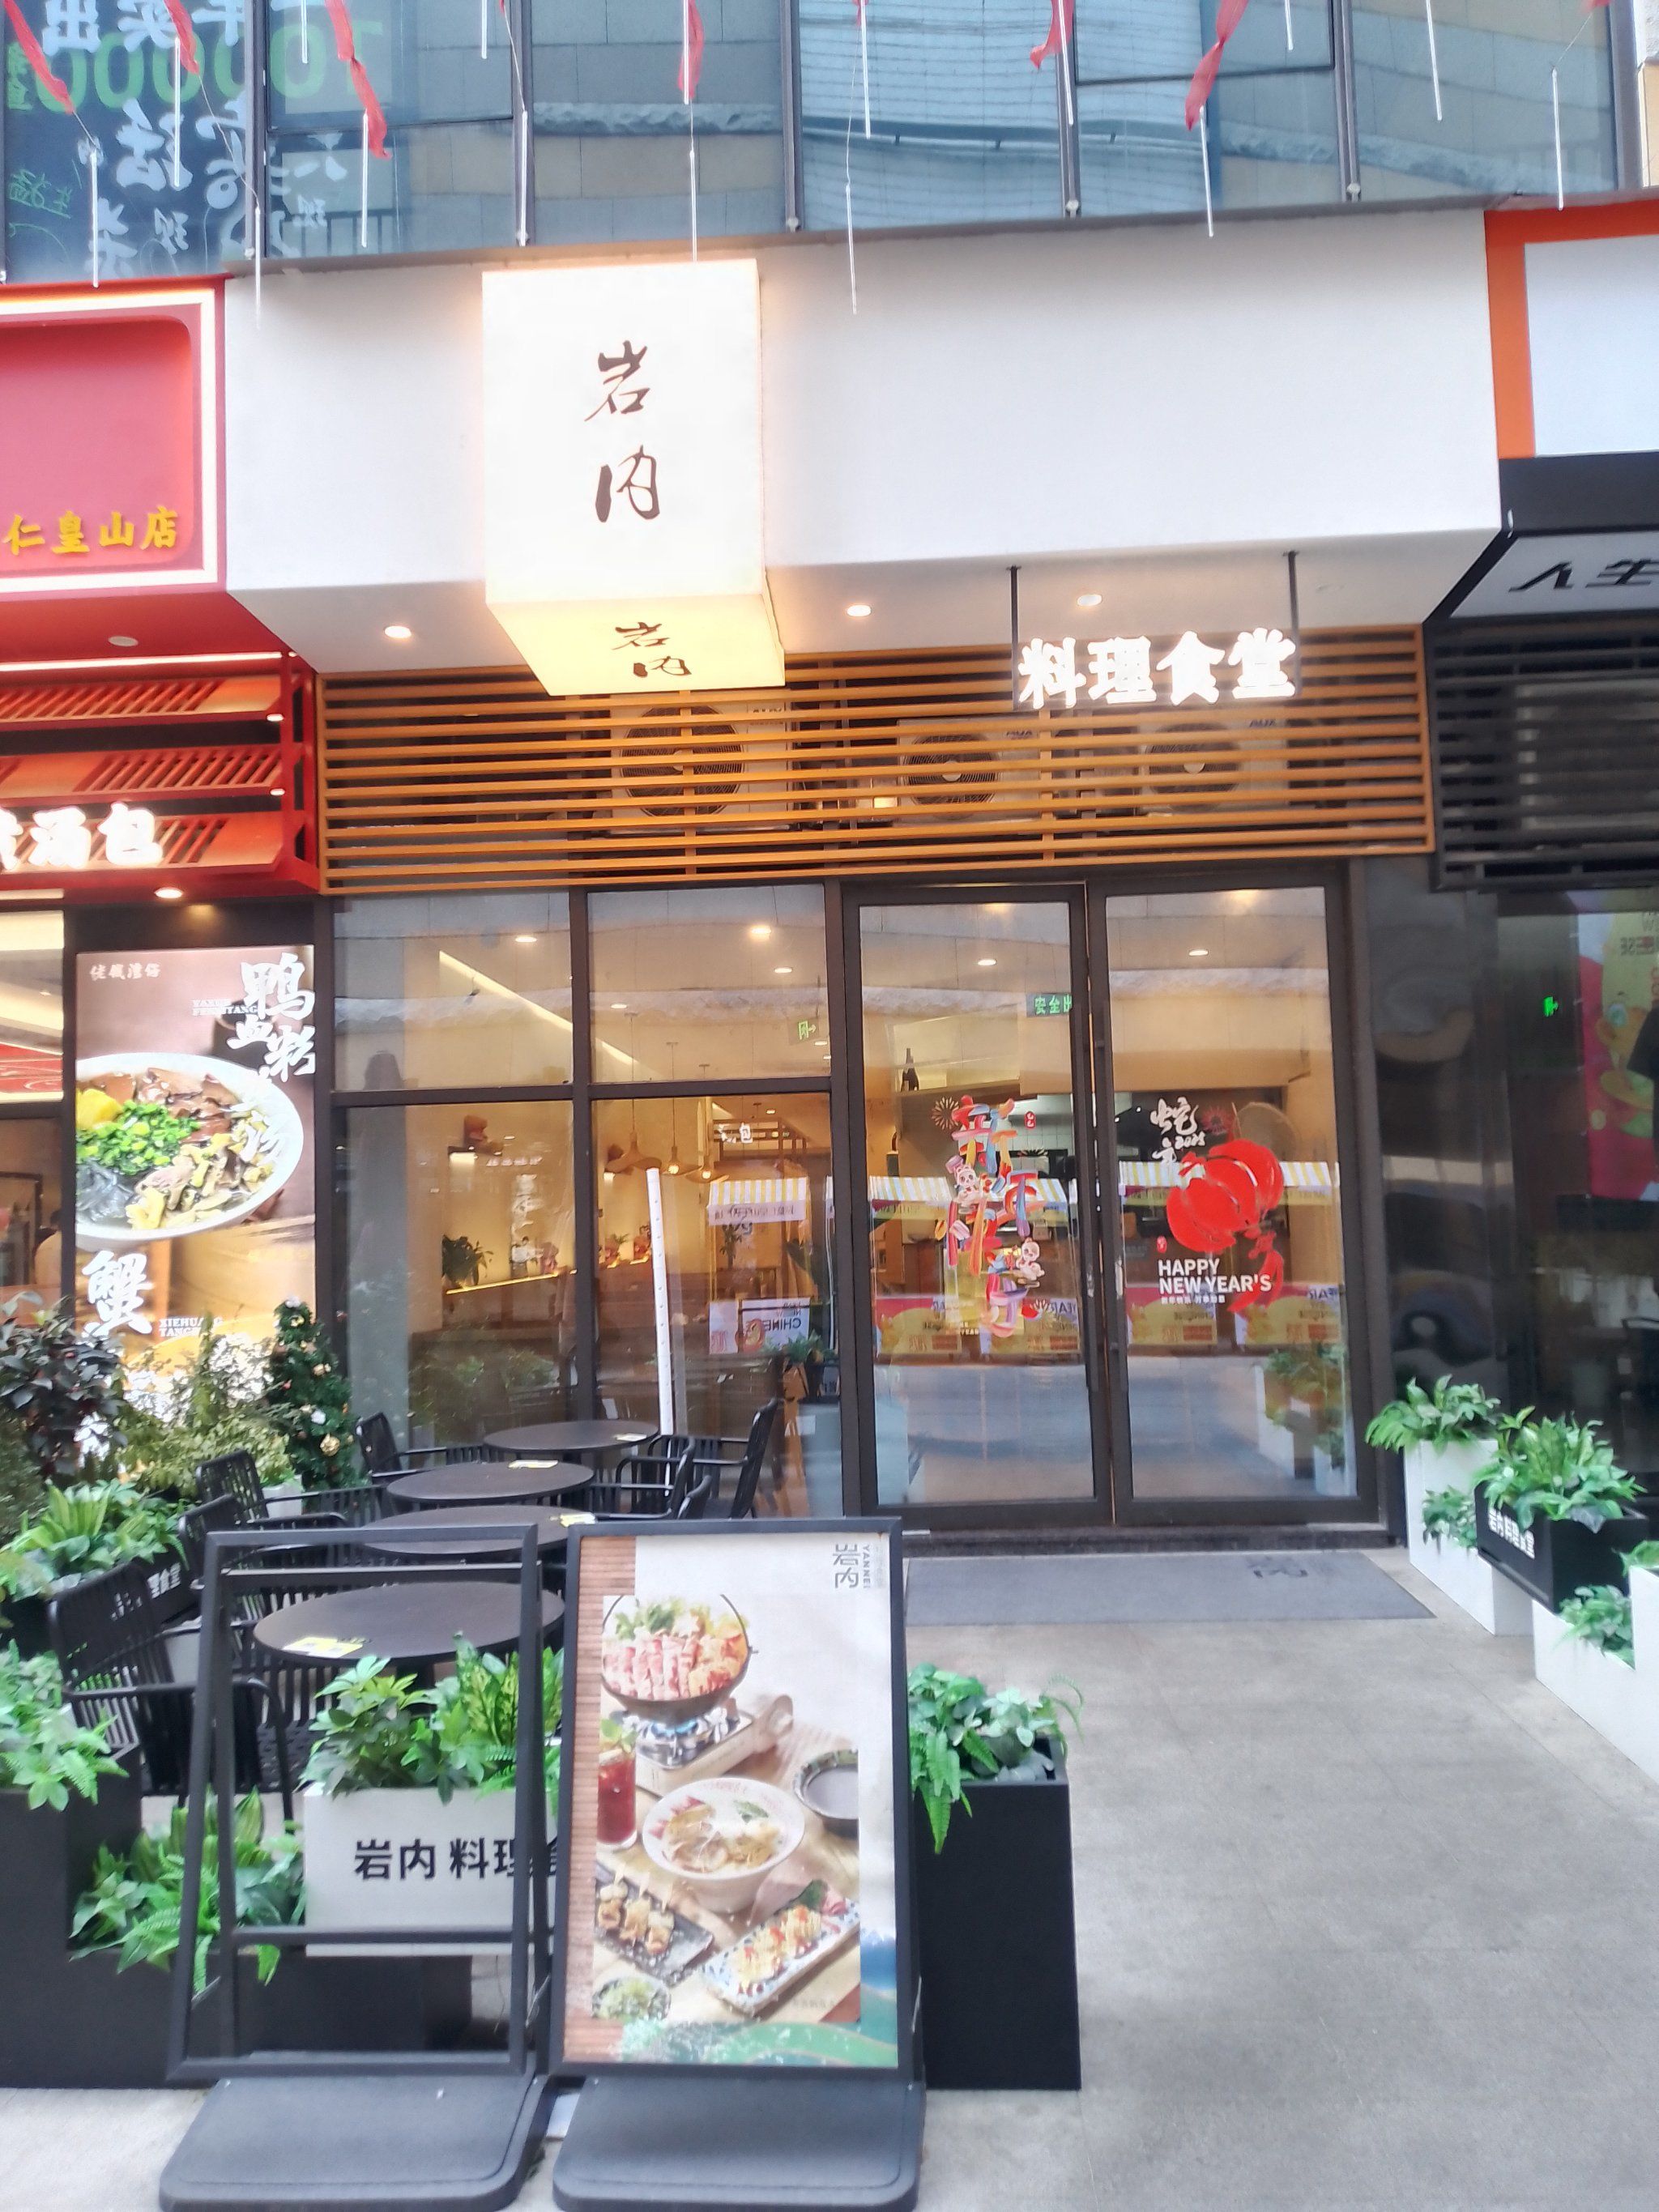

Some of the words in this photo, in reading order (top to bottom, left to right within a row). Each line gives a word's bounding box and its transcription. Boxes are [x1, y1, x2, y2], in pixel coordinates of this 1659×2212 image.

[585, 339, 661, 523] 岩内
[2, 505, 179, 556] 仁皇山店
[611, 620, 693, 678] 岩内
[1017, 627, 1296, 710] 料理食堂
[1158, 1258, 1220, 1276] HAPPY
[1158, 1276, 1202, 1295] NEW
[1206, 1274, 1273, 1294] YEAR'S
[833, 1544, 860, 1589] 岩内
[863, 1544, 871, 1589] YANNEI
